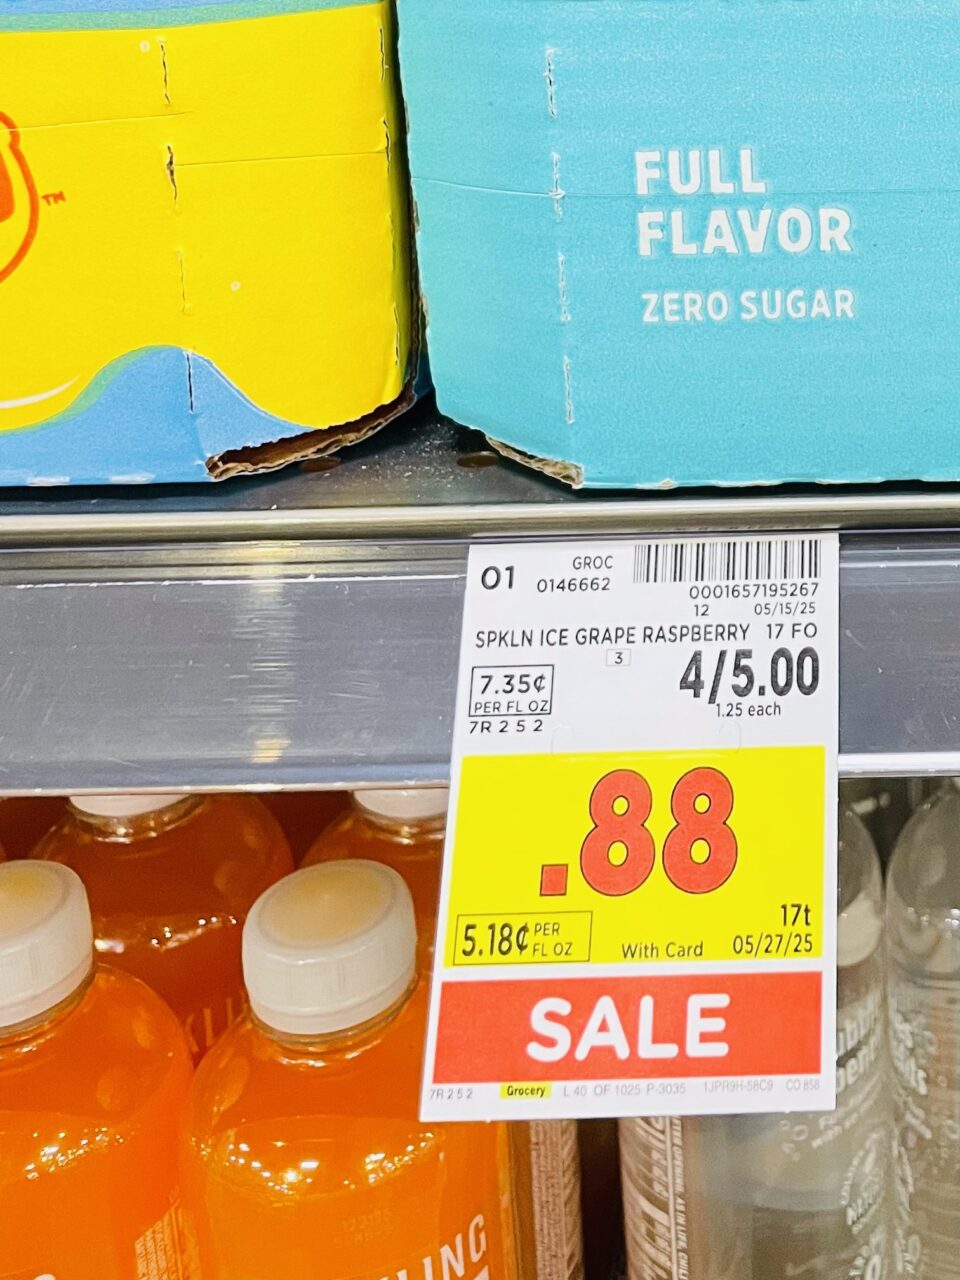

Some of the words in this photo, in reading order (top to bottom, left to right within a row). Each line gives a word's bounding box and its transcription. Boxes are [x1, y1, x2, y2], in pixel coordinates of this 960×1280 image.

[635, 148, 766, 195] FULL
[637, 207, 852, 256] FLAVOR
[641, 291, 729, 322] ZERO
[740, 288, 856, 320] SUGAR
[572, 555, 614, 570] GROC
[536, 577, 611, 593] 0146662
[689, 582, 819, 600] 0001657195267
[693, 604, 710, 617] 12
[754, 601, 816, 616] 05/15/25
[475, 630, 533, 649] SPKLN
[540, 628, 569, 647] ICE
[575, 627, 637, 645] GRAPE
[642, 623, 751, 643] RASPBERRY
[766, 623, 783, 640] 17
[791, 622, 818, 639] FO
[613, 652, 624, 665] 3
[480, 673, 547, 696] 7.35¢
[679, 646, 820, 704] 4/5.00
[474, 701, 501, 714] PER
[506, 701, 524, 713] FL
[528, 699, 550, 713] OZ
[716, 702, 743, 717] 1.25
[748, 701, 782, 717] each
[539, 766, 738, 898] .88
[780, 904, 812, 927] 17t
[461, 922, 530, 957] 5.18¢
[534, 923, 560, 937] PER
[532, 944, 547, 957] FL
[553, 942, 573, 956] OZ
[621, 941, 660, 959] With
[665, 941, 705, 958] Card
[732, 933, 814, 957] 05/27/25
[525, 993, 731, 1063] SALE
[506, 1085, 546, 1098] Grocery
